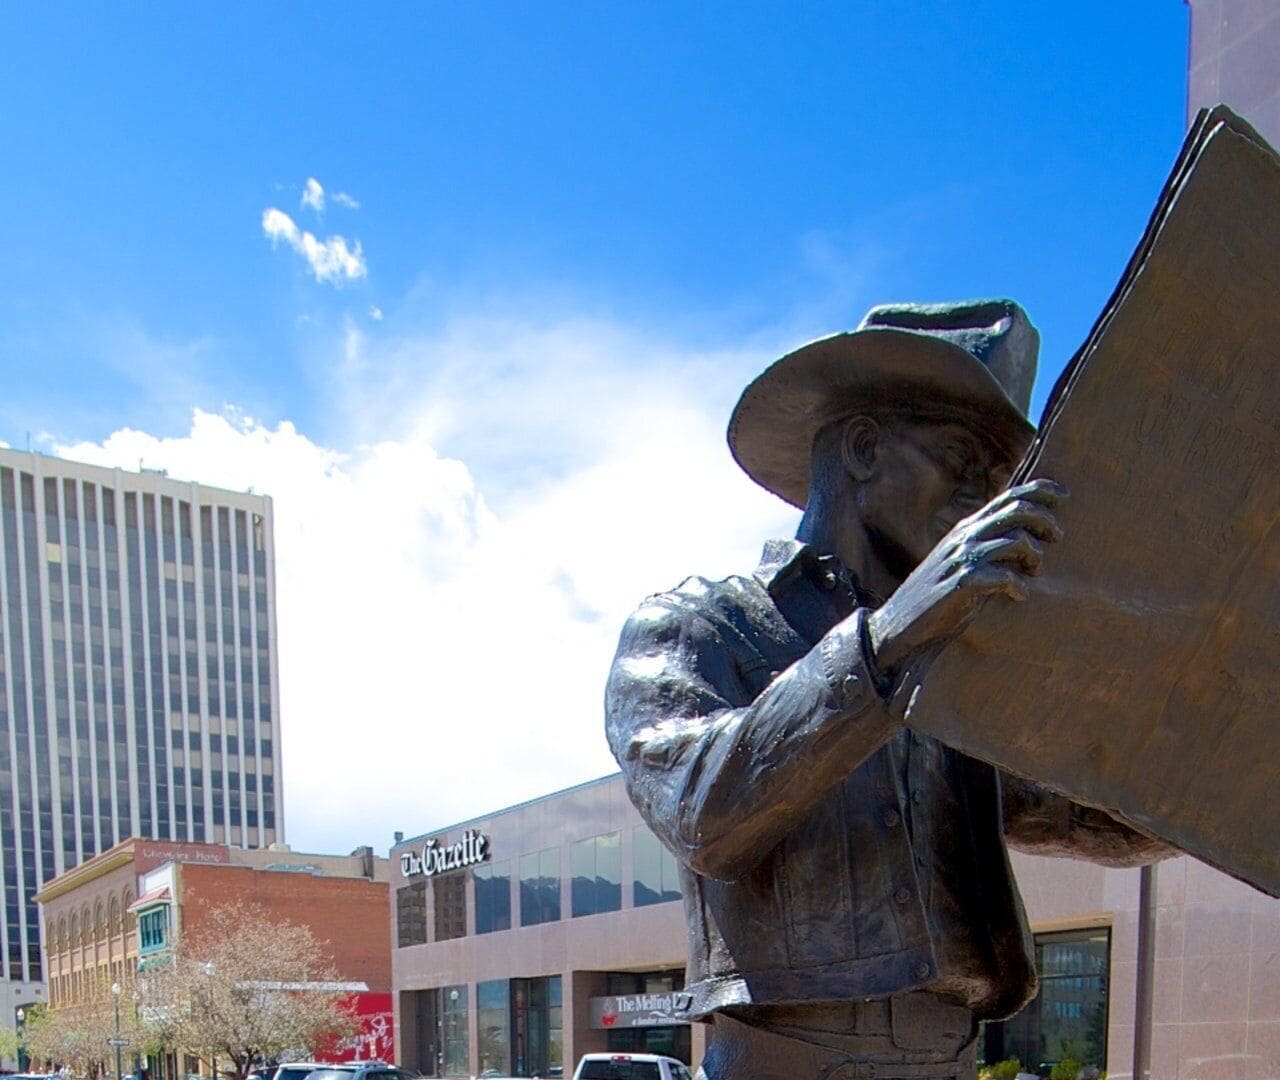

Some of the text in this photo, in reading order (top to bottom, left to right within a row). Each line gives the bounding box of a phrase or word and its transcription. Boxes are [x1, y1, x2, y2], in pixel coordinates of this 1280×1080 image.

[400, 828, 485, 877] The Gazette
[616, 996, 634, 1012] The
